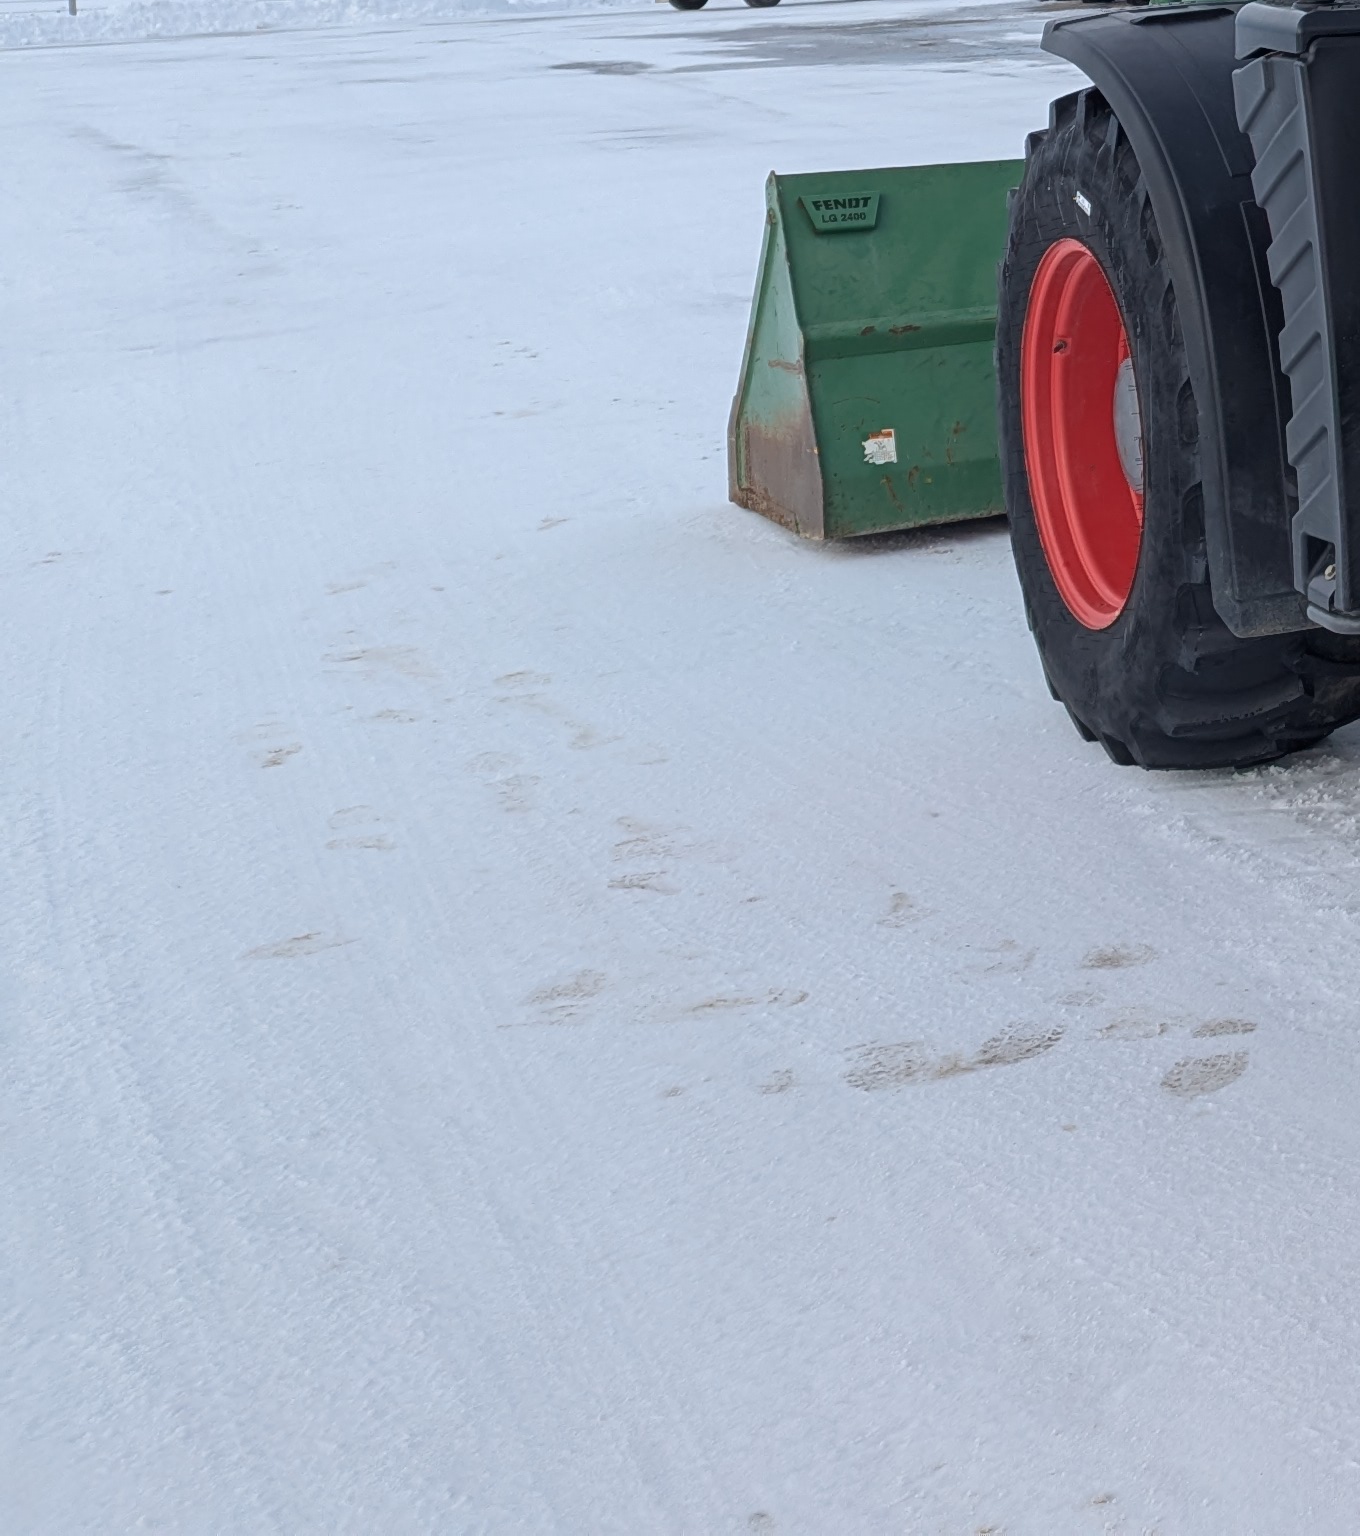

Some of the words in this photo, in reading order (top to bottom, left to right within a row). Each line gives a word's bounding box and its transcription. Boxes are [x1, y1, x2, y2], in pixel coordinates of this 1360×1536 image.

[811, 196, 872, 211] FENDT
[821, 213, 838, 224] LG
[840, 212, 867, 222] 2400
